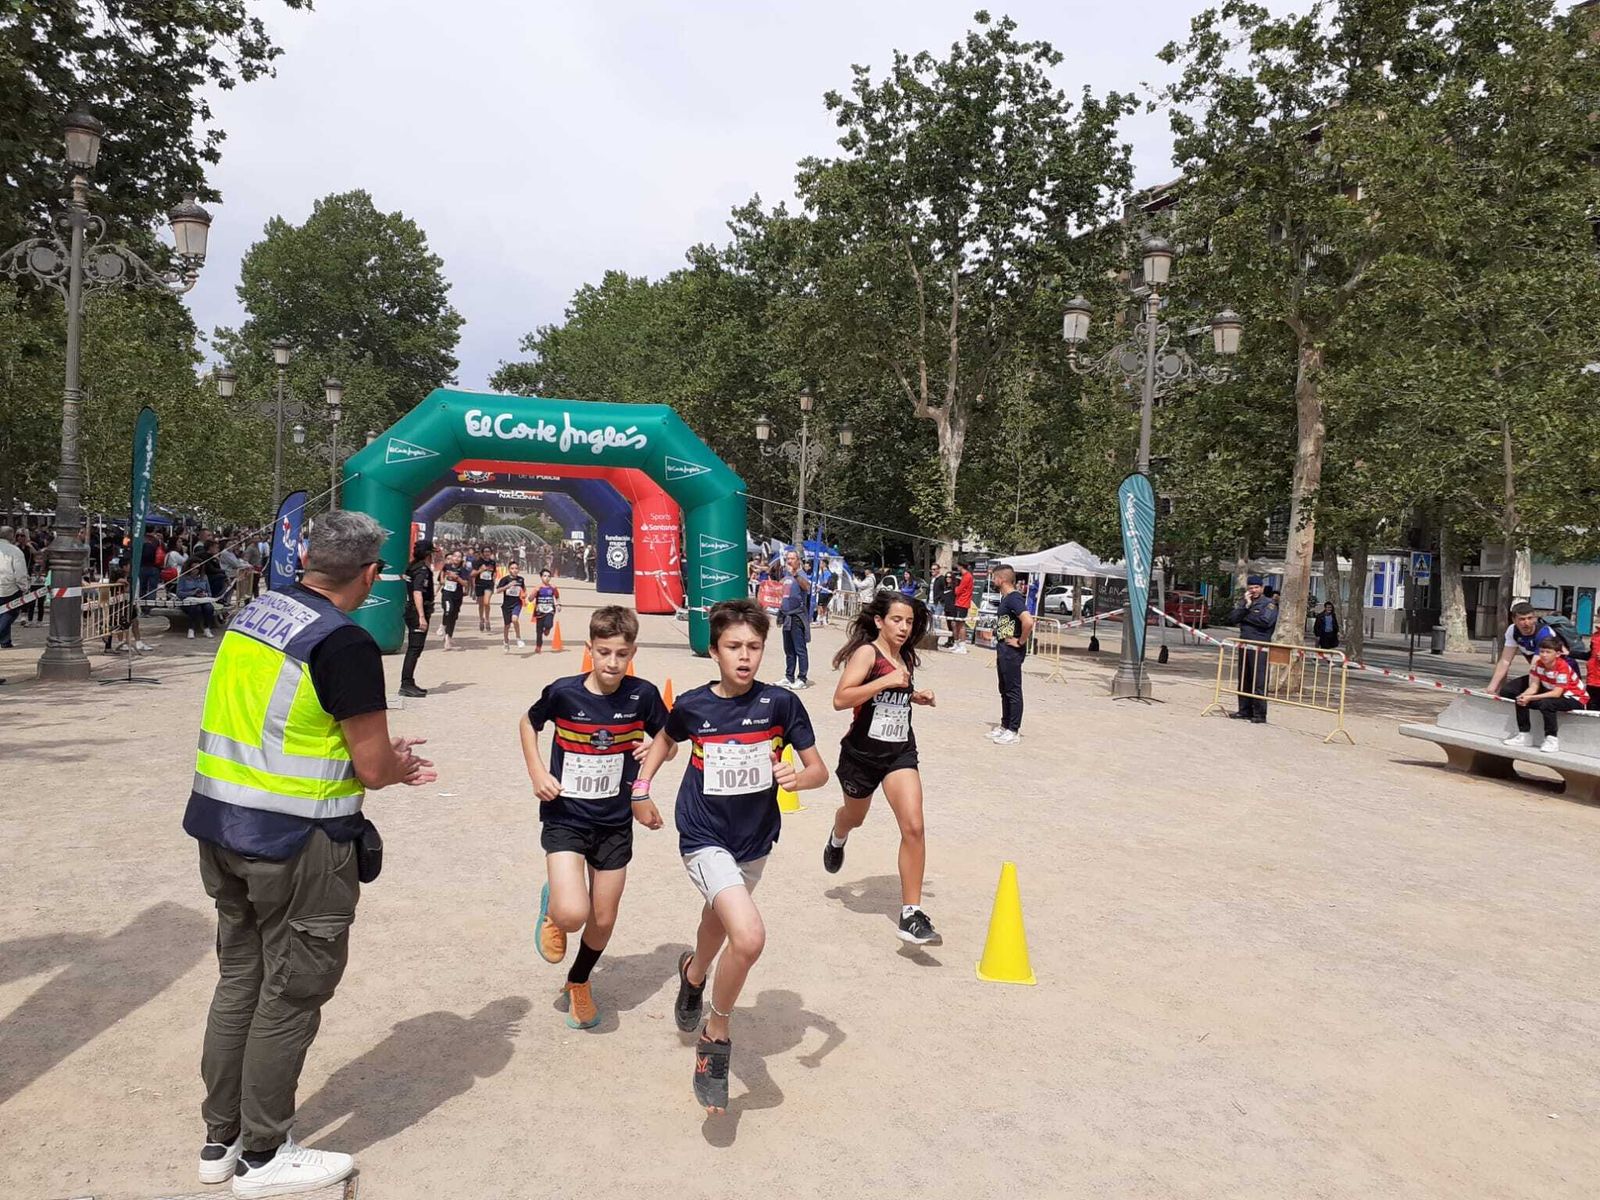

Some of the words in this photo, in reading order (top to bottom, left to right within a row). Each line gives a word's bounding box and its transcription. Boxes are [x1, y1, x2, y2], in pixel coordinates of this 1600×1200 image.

[465, 409, 493, 437] El
[494, 413, 557, 443] Corte
[559, 412, 647, 454] Inglés
[498, 493, 543, 501] NACIONAL
[881, 723, 905, 738] 1041
[575, 775, 610, 793] 1010
[716, 767, 761, 788] 1020
